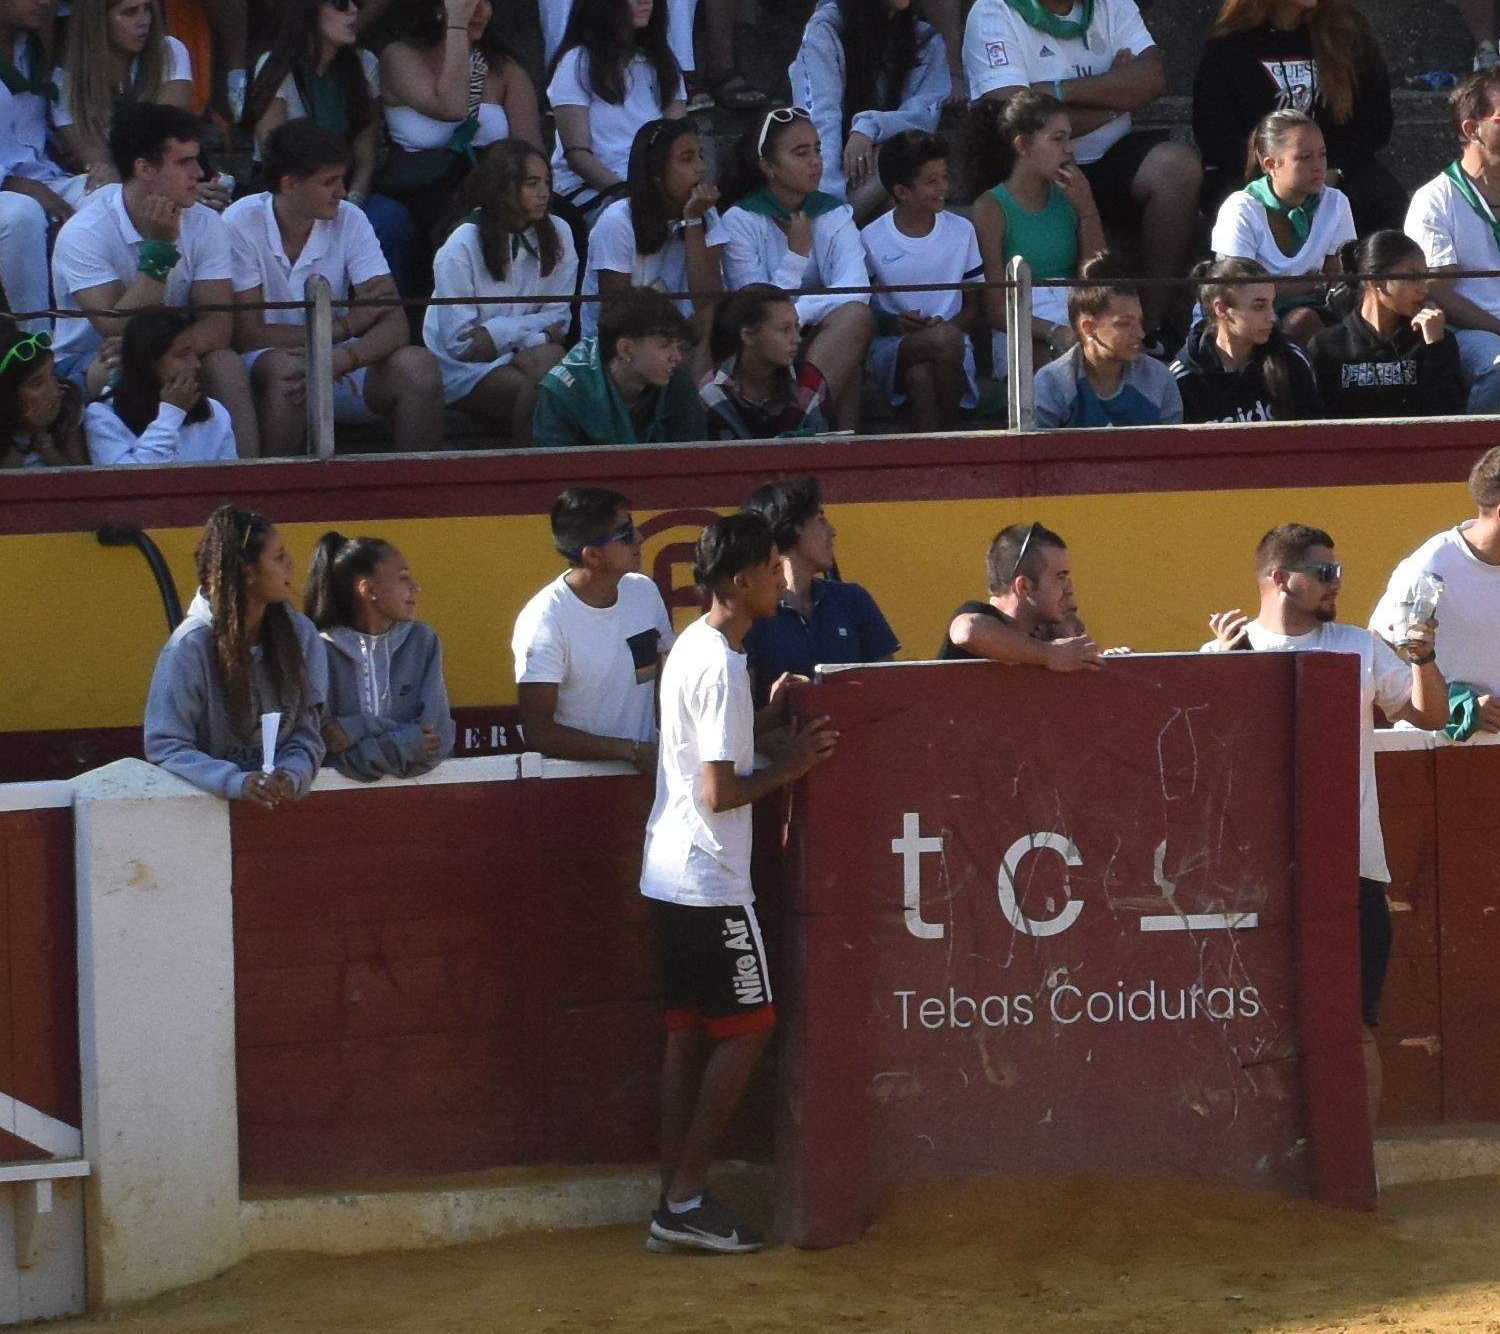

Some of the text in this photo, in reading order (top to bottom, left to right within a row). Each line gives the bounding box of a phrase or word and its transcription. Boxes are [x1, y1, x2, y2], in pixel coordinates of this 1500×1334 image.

[1271, 64, 1320, 79] GUES
[721, 917, 766, 1007] Nike Air
[894, 978, 1262, 1032] Tebas Coiduras
